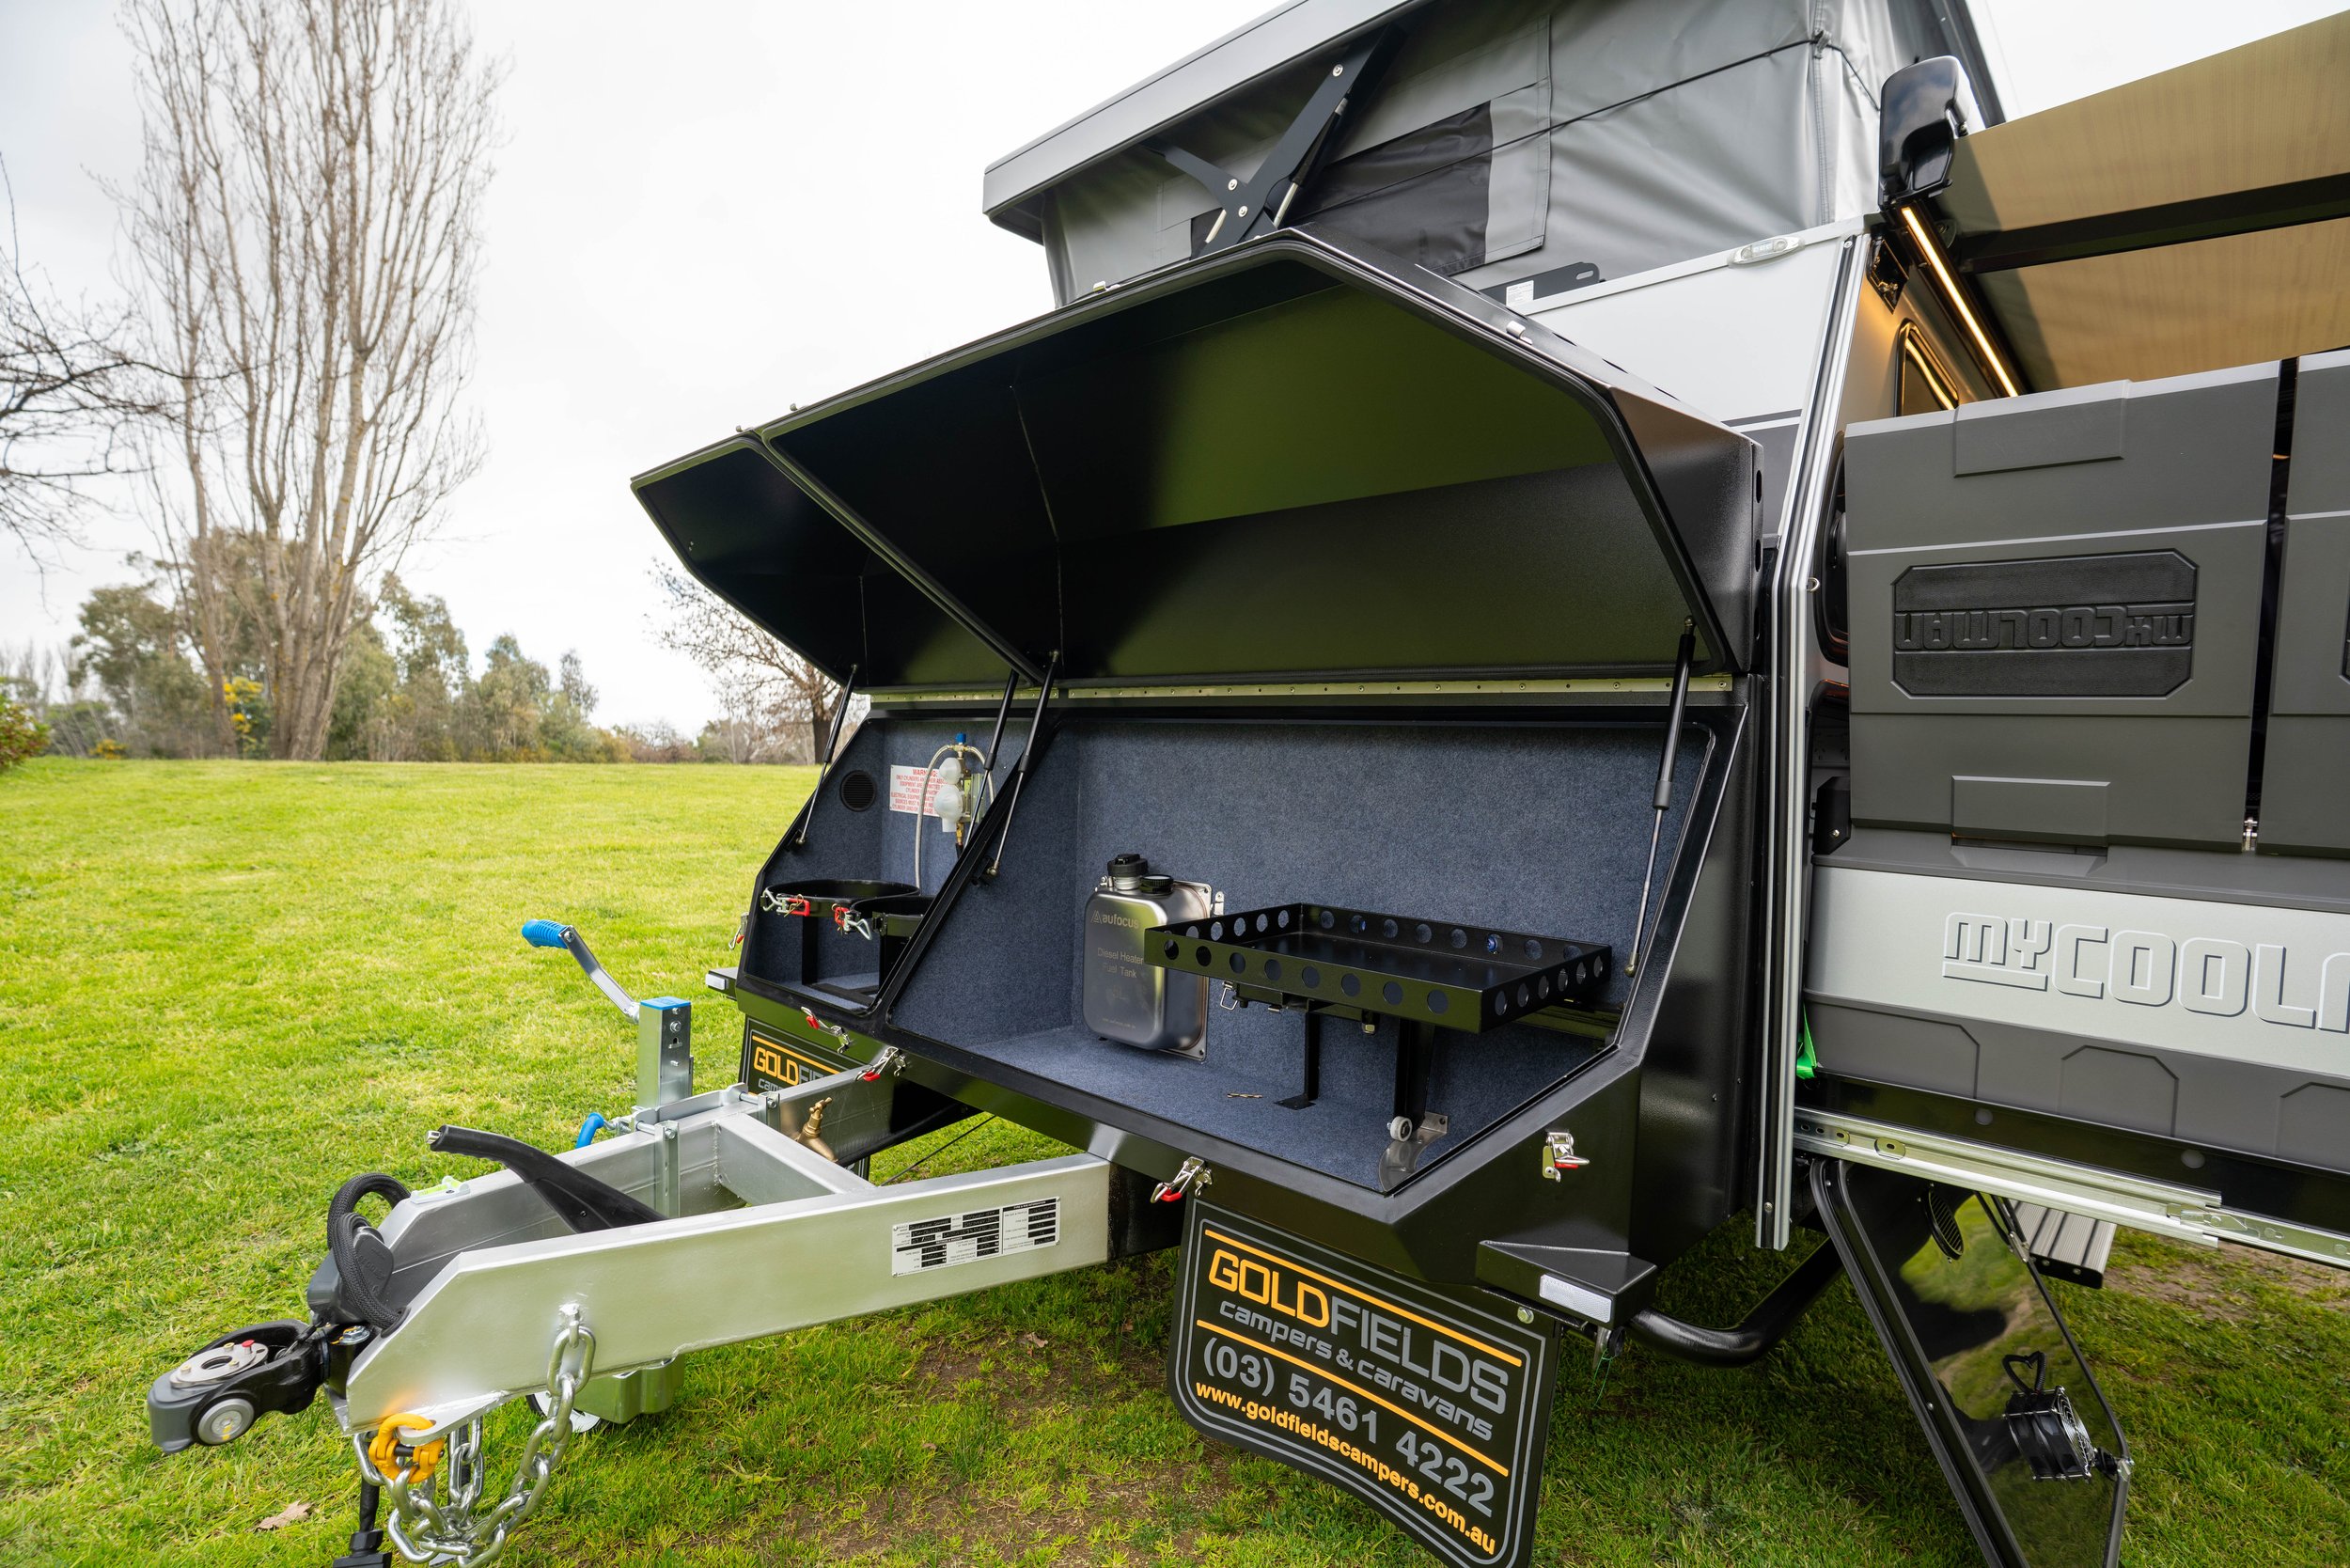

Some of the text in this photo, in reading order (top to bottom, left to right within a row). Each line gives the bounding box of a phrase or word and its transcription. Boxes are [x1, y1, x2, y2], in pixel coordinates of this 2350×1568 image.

[1097, 947, 1144, 964] Diesel Heater
[1102, 913, 1139, 930] aufocus
[1120, 965, 1137, 979] Tank
[1208, 1248, 1509, 1414] GOLDFIELDS
[1219, 1300, 1493, 1441] campers & caravans
[1195, 1381, 1496, 1555] www.goldfieldscampers.com.au
[1203, 1337, 1494, 1518] (03) 5461 4222
